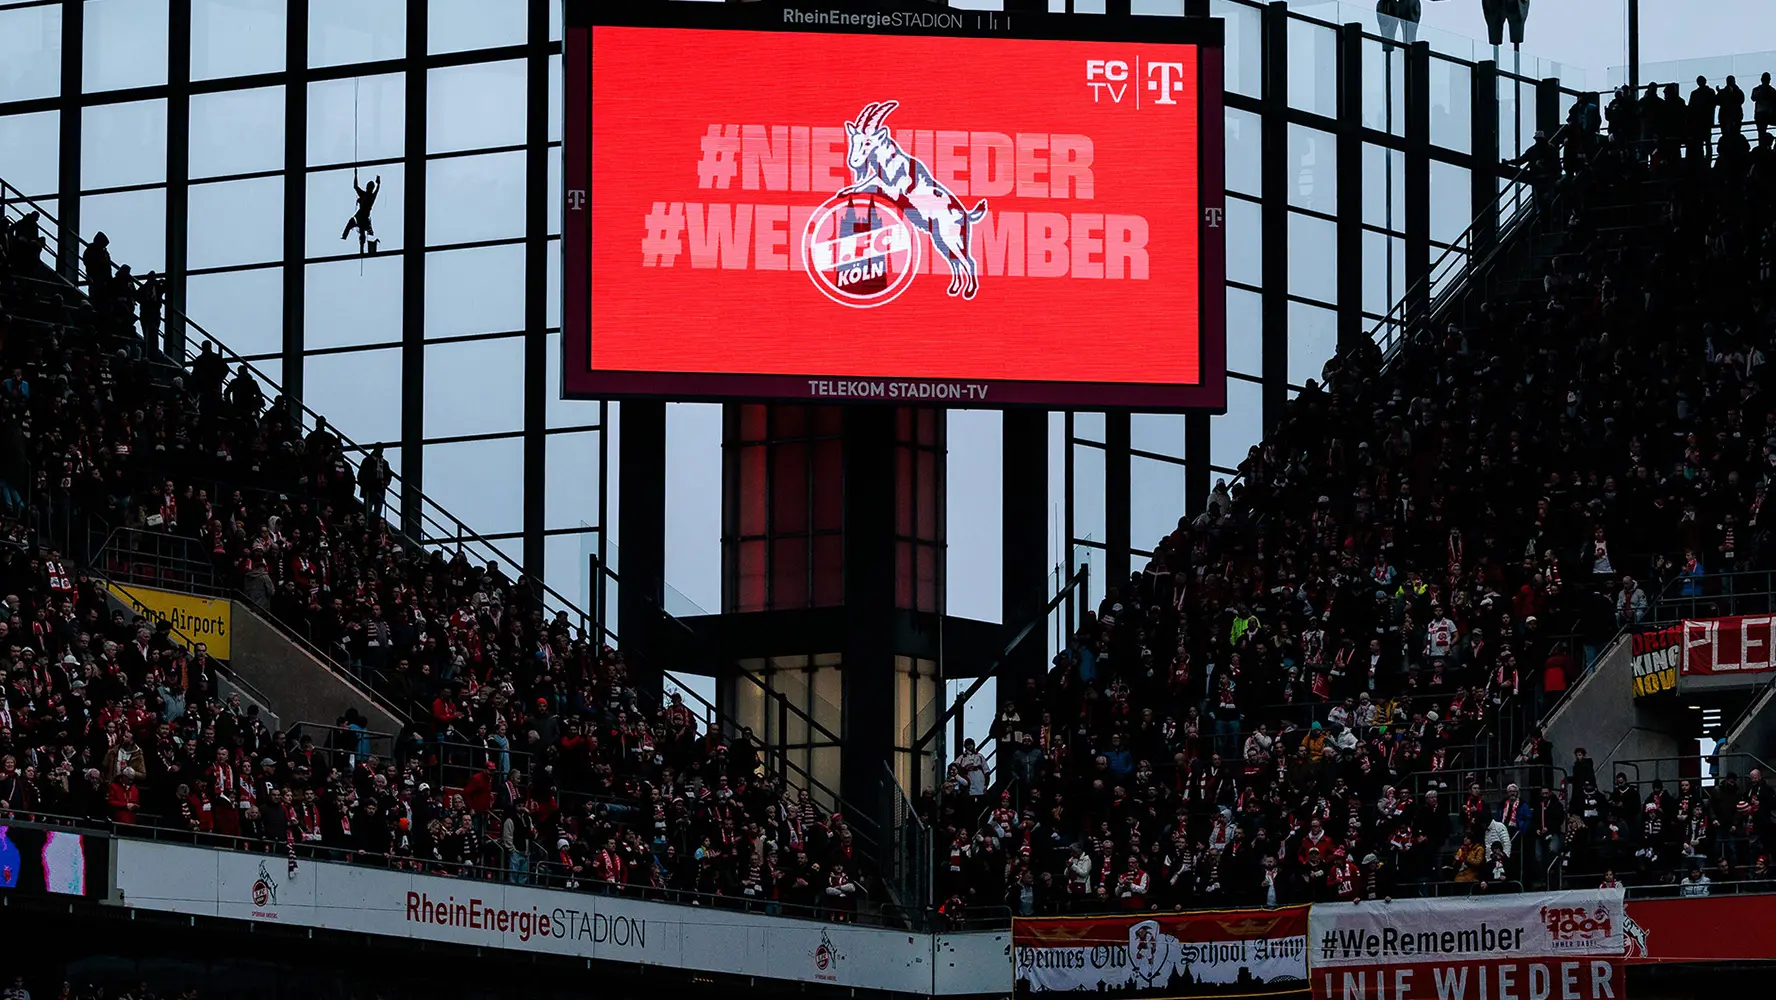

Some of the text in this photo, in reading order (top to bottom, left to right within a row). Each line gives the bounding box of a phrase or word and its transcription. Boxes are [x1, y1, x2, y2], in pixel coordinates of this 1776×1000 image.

[783, 8, 963, 28] RheinEnergieSTADION
[1086, 59, 1129, 81] FC
[1086, 82, 1128, 103] TV
[837, 260, 885, 287] KÖLN
[808, 380, 989, 399] TELEKOM STADION-TV
[171, 607, 225, 637] Airport
[1682, 617, 1776, 671] PLE
[406, 891, 645, 948] RheinEnergieSTADION
[1018, 936, 1304, 972] Hennes Old School Army
[1321, 922, 1525, 959] #WeRemember
[1432, 960, 1615, 1000] WIEDER
